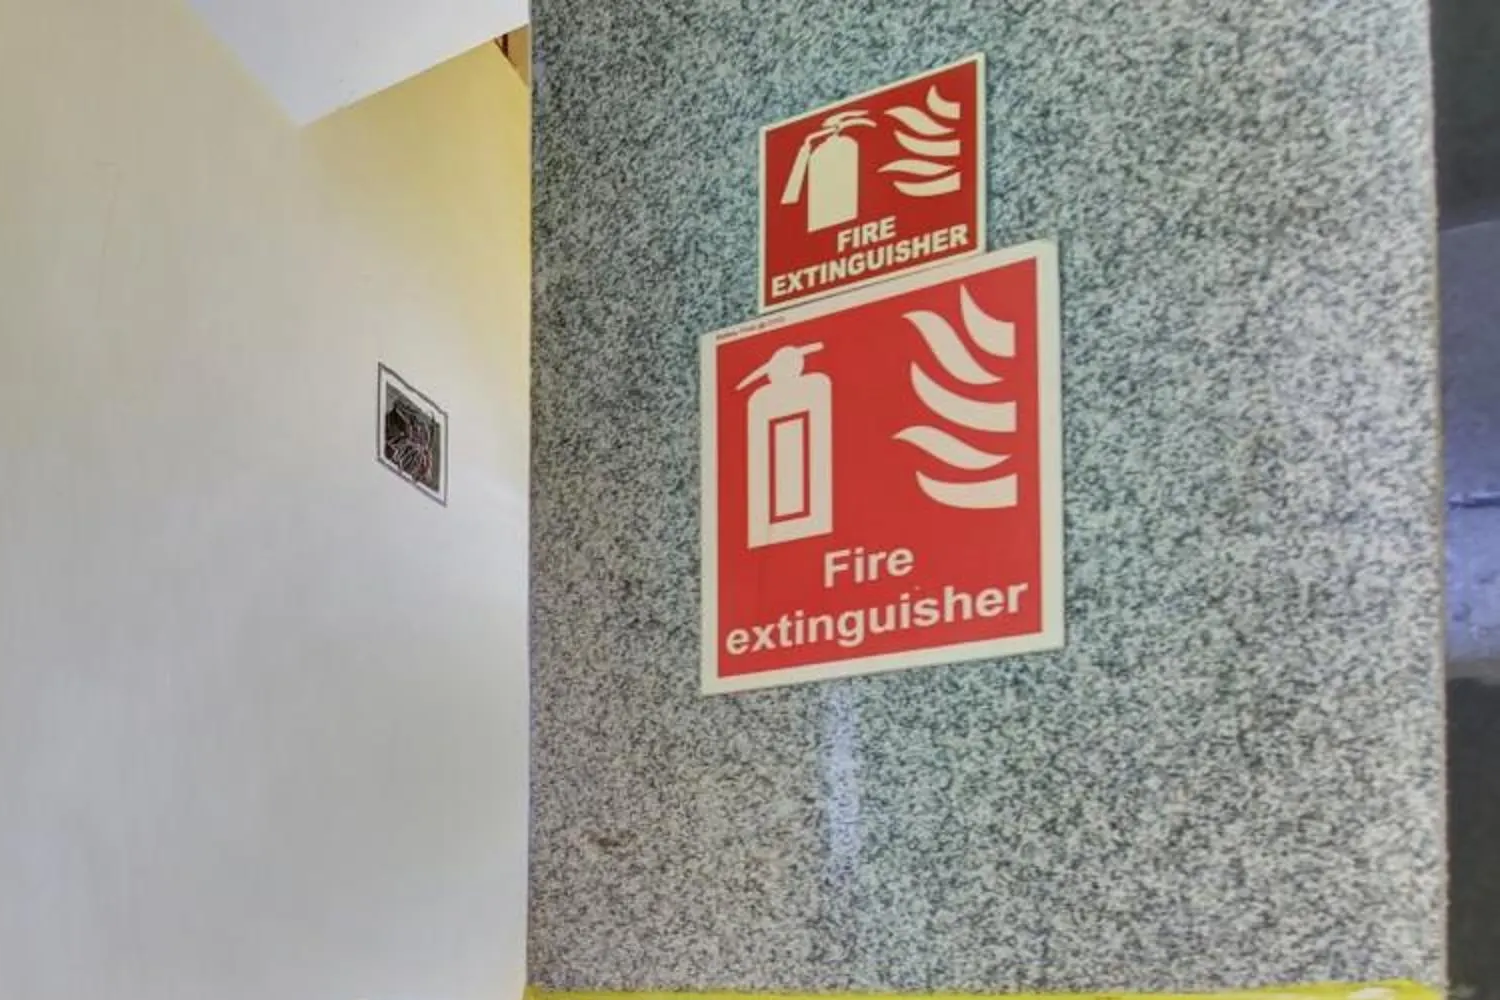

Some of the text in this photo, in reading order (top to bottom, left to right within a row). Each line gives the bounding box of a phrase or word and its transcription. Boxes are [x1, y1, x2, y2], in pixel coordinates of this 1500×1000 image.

[771, 223, 969, 298] EXTINGUISHER
[836, 215, 897, 252] FIRE
[823, 547, 915, 588] Fire
[725, 582, 1029, 655] extinguisher
